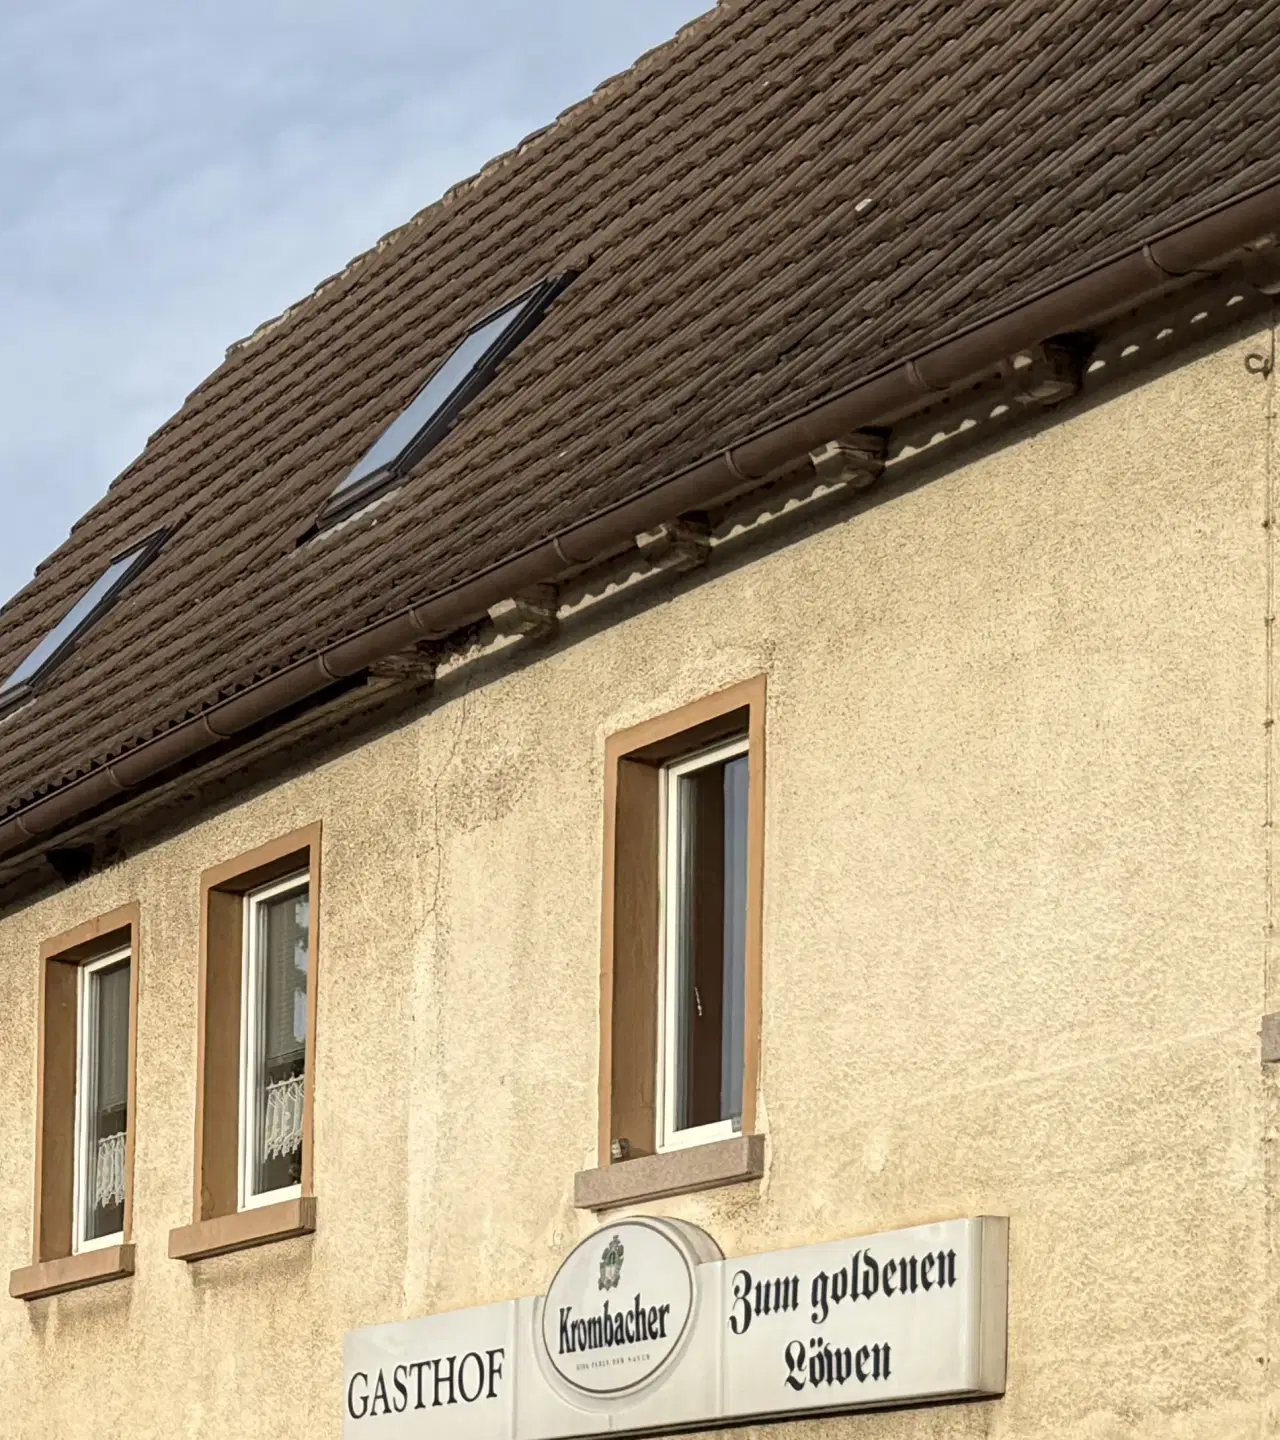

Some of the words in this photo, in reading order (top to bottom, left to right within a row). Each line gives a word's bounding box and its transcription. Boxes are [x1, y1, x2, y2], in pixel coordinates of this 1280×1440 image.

[558, 1292, 670, 1354] Krombacher
[728, 1269, 800, 1335] Zum
[811, 1247, 957, 1325] goldenen
[347, 1347, 505, 1420] GASTHOF
[784, 1336, 892, 1391] Löwen
